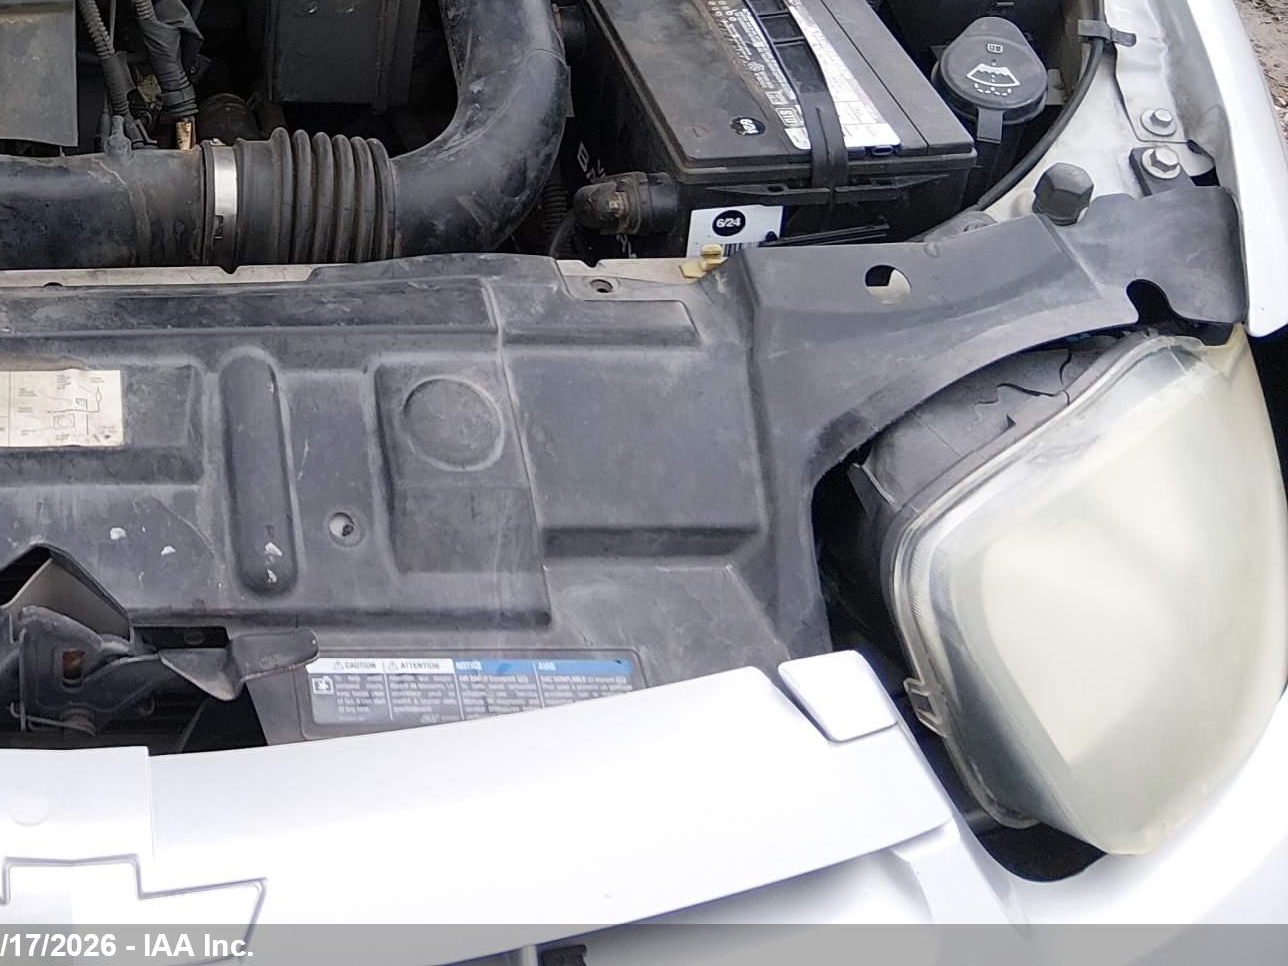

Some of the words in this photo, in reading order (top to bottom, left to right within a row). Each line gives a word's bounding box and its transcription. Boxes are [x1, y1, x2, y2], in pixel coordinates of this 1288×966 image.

[716, 217, 742, 228] 6/24
[400, 661, 440, 669] ATTENTION
[455, 661, 482, 670] NOTICE
